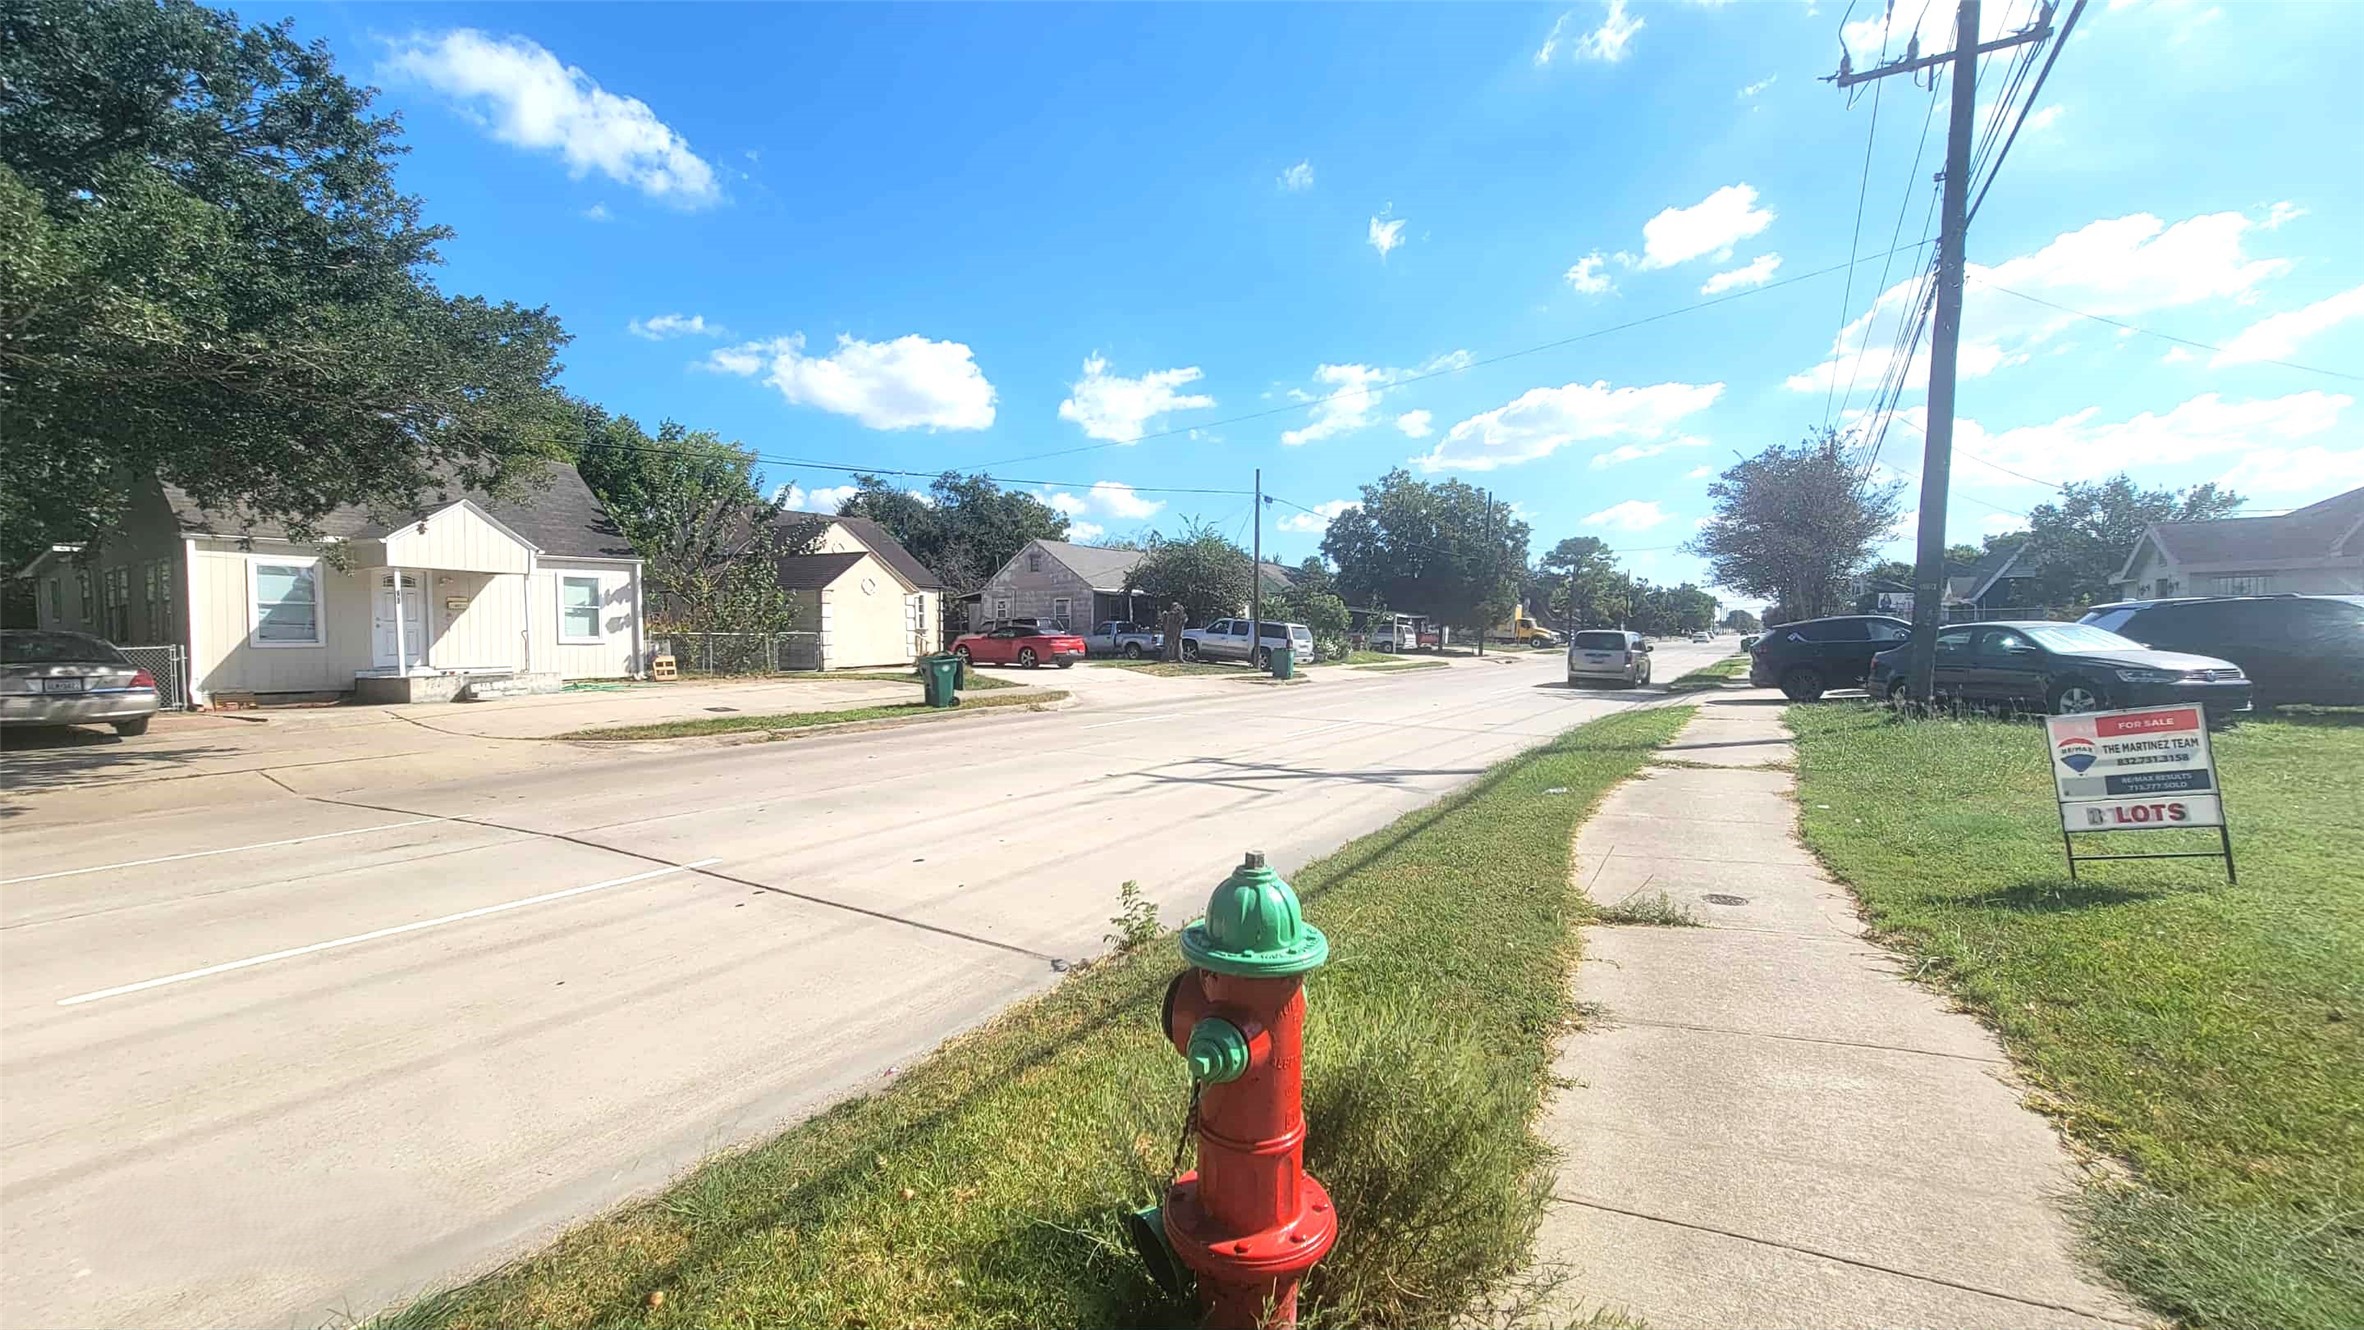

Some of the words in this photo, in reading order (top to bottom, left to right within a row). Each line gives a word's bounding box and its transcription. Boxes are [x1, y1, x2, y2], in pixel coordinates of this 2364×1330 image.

[2118, 720, 2142, 729] FOR
[2144, 717, 2175, 728] SALE
[2102, 744, 2120, 754] THE
[2122, 740, 2170, 753] MARTINEZ
[2172, 738, 2199, 749] TEAM
[2121, 774, 2154, 784] RE/MAX
[2115, 803, 2187, 824] LOTS
